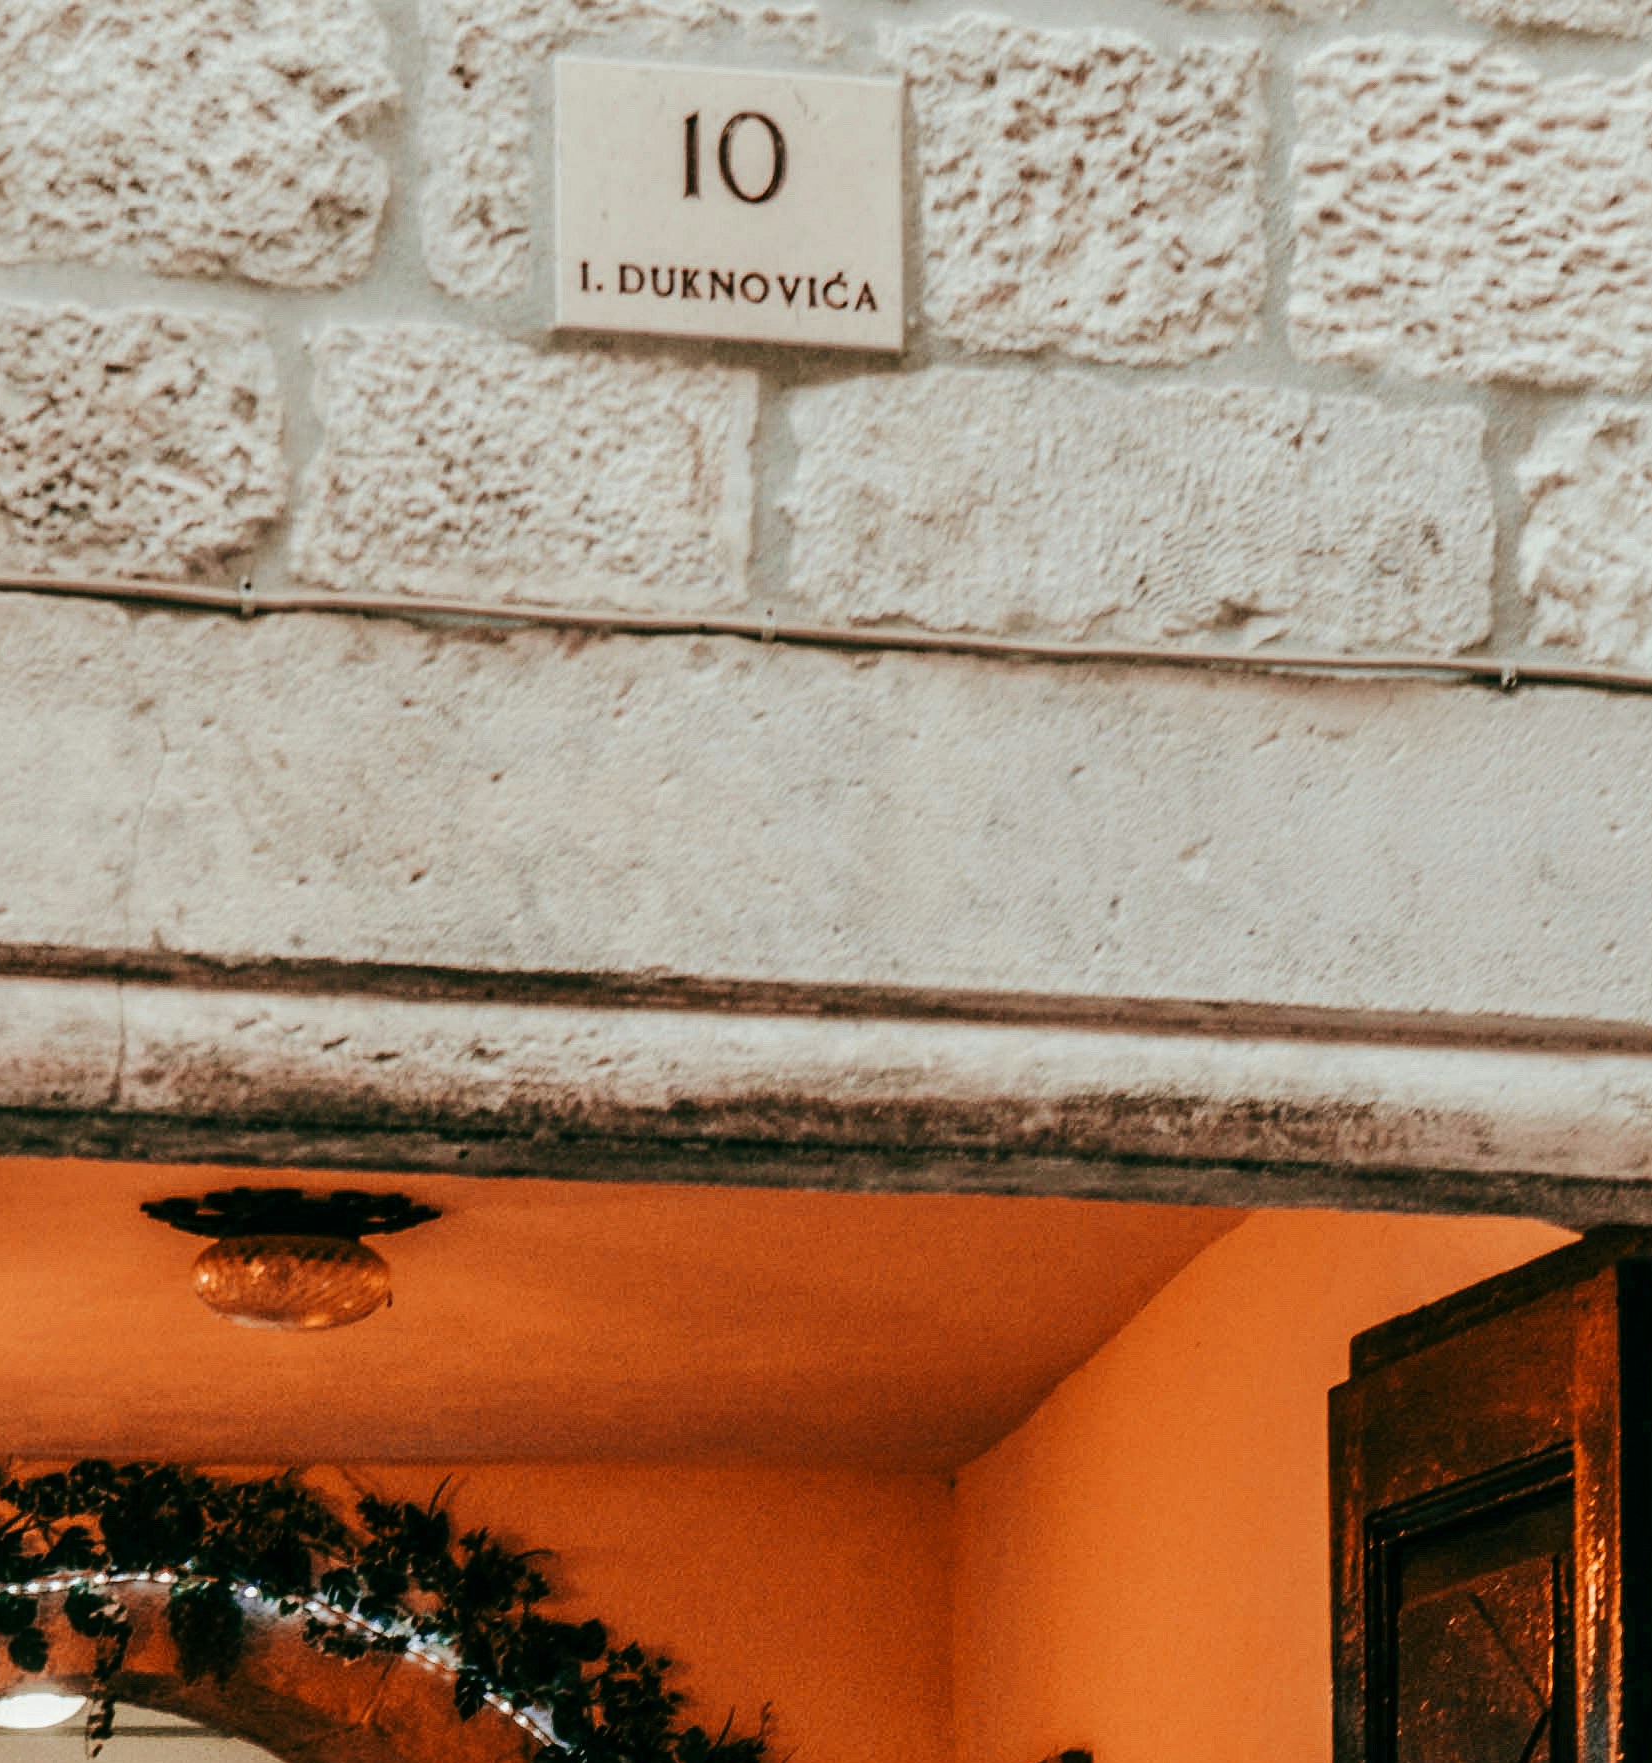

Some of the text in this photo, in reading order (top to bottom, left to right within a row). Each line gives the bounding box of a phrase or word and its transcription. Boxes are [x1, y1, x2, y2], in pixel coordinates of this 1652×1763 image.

[683, 111, 787, 204] 10
[579, 260, 879, 312] I. DUKNOVIĆA
